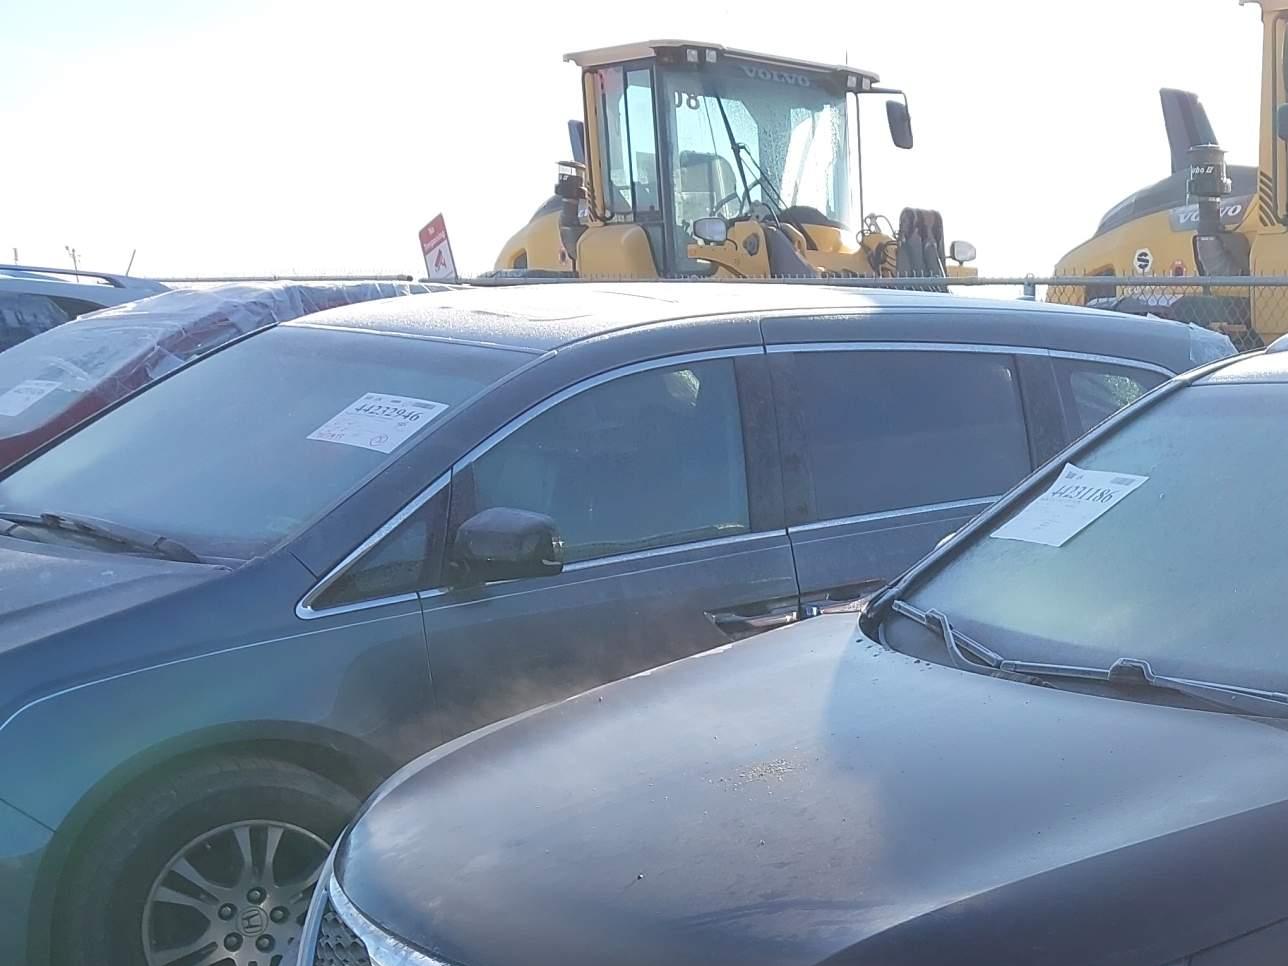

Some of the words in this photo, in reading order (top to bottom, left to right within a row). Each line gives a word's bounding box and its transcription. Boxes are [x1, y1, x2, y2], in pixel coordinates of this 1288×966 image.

[742, 66, 810, 86] VOLVO
[1179, 205, 1241, 223] VOVO
[355, 403, 424, 421] 44232946
[1052, 485, 1119, 503] 44231186
